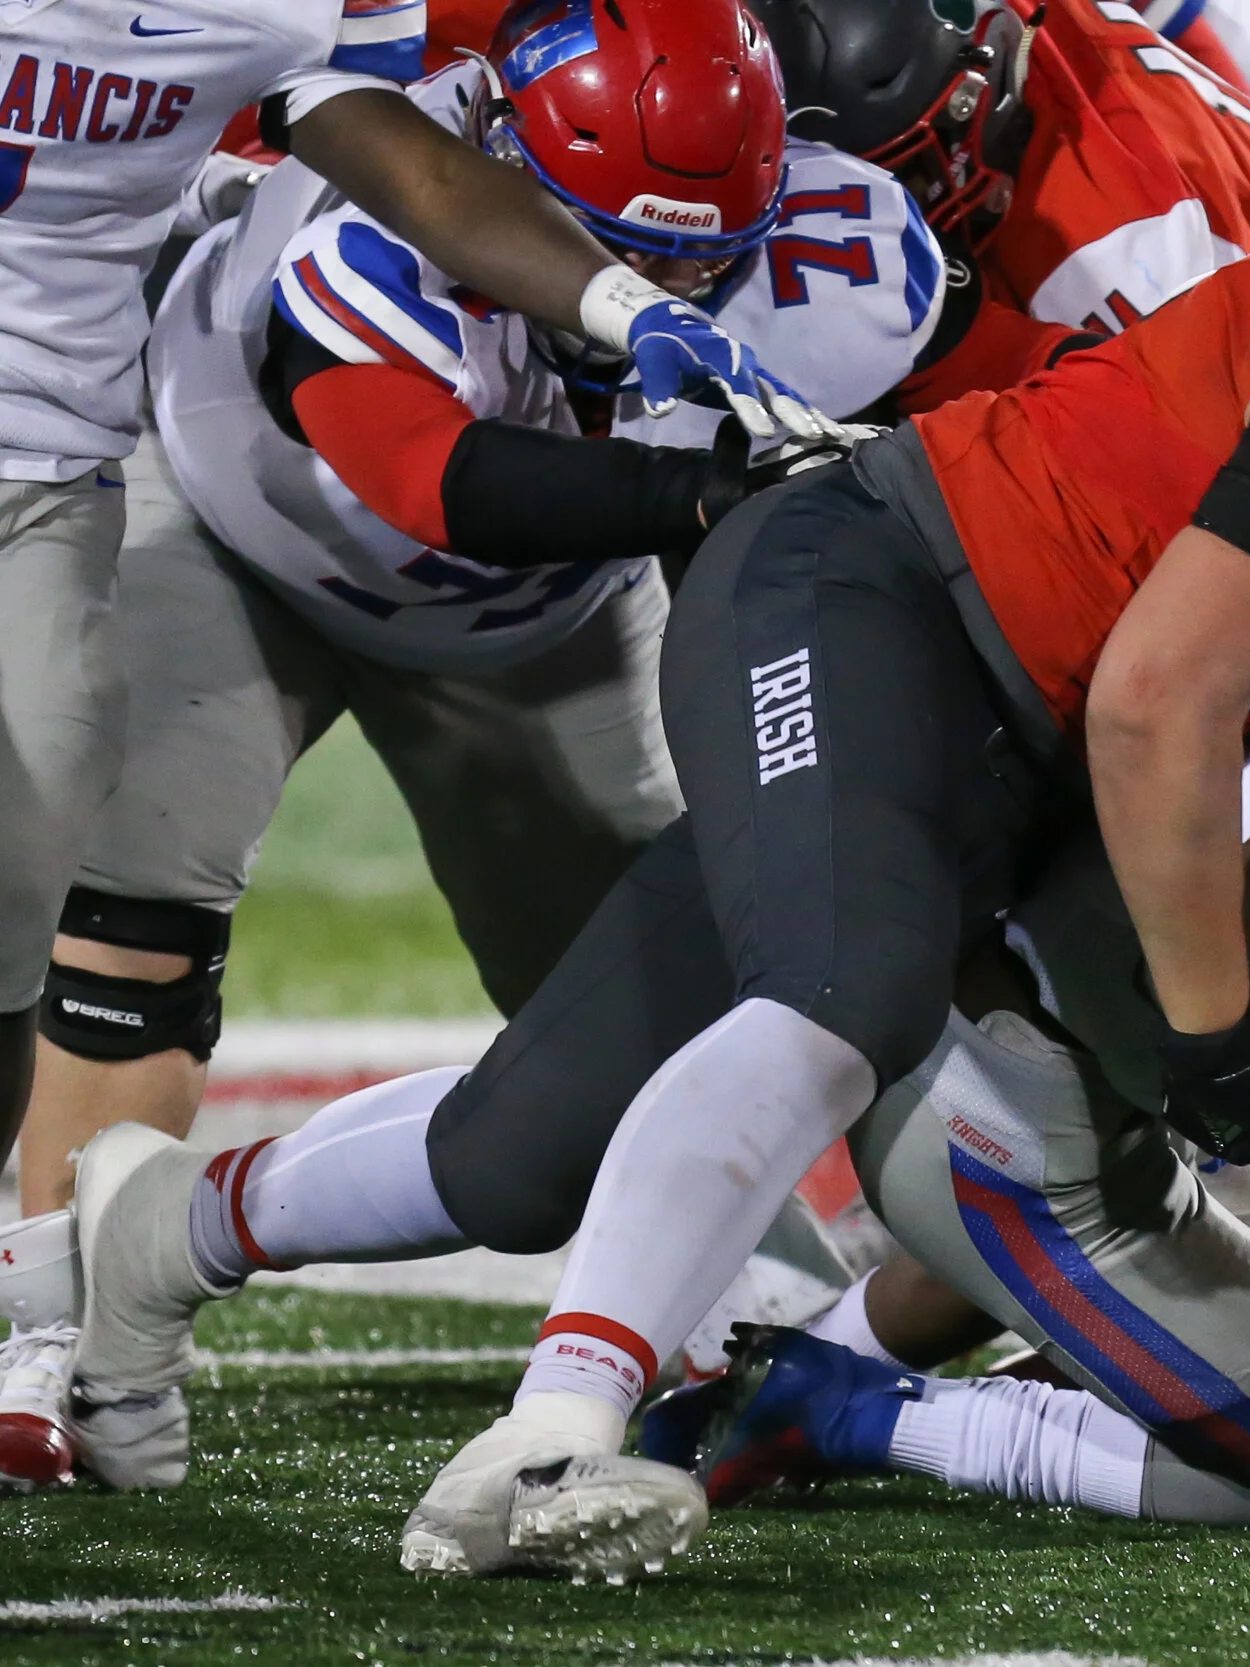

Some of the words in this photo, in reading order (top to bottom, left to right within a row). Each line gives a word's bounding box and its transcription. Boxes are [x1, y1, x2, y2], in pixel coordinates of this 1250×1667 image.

[641, 203, 716, 228] Riddell
[764, 183, 880, 309] 71
[750, 647, 818, 786] IRISH
[946, 1114, 1014, 1166] KNIGHTS
